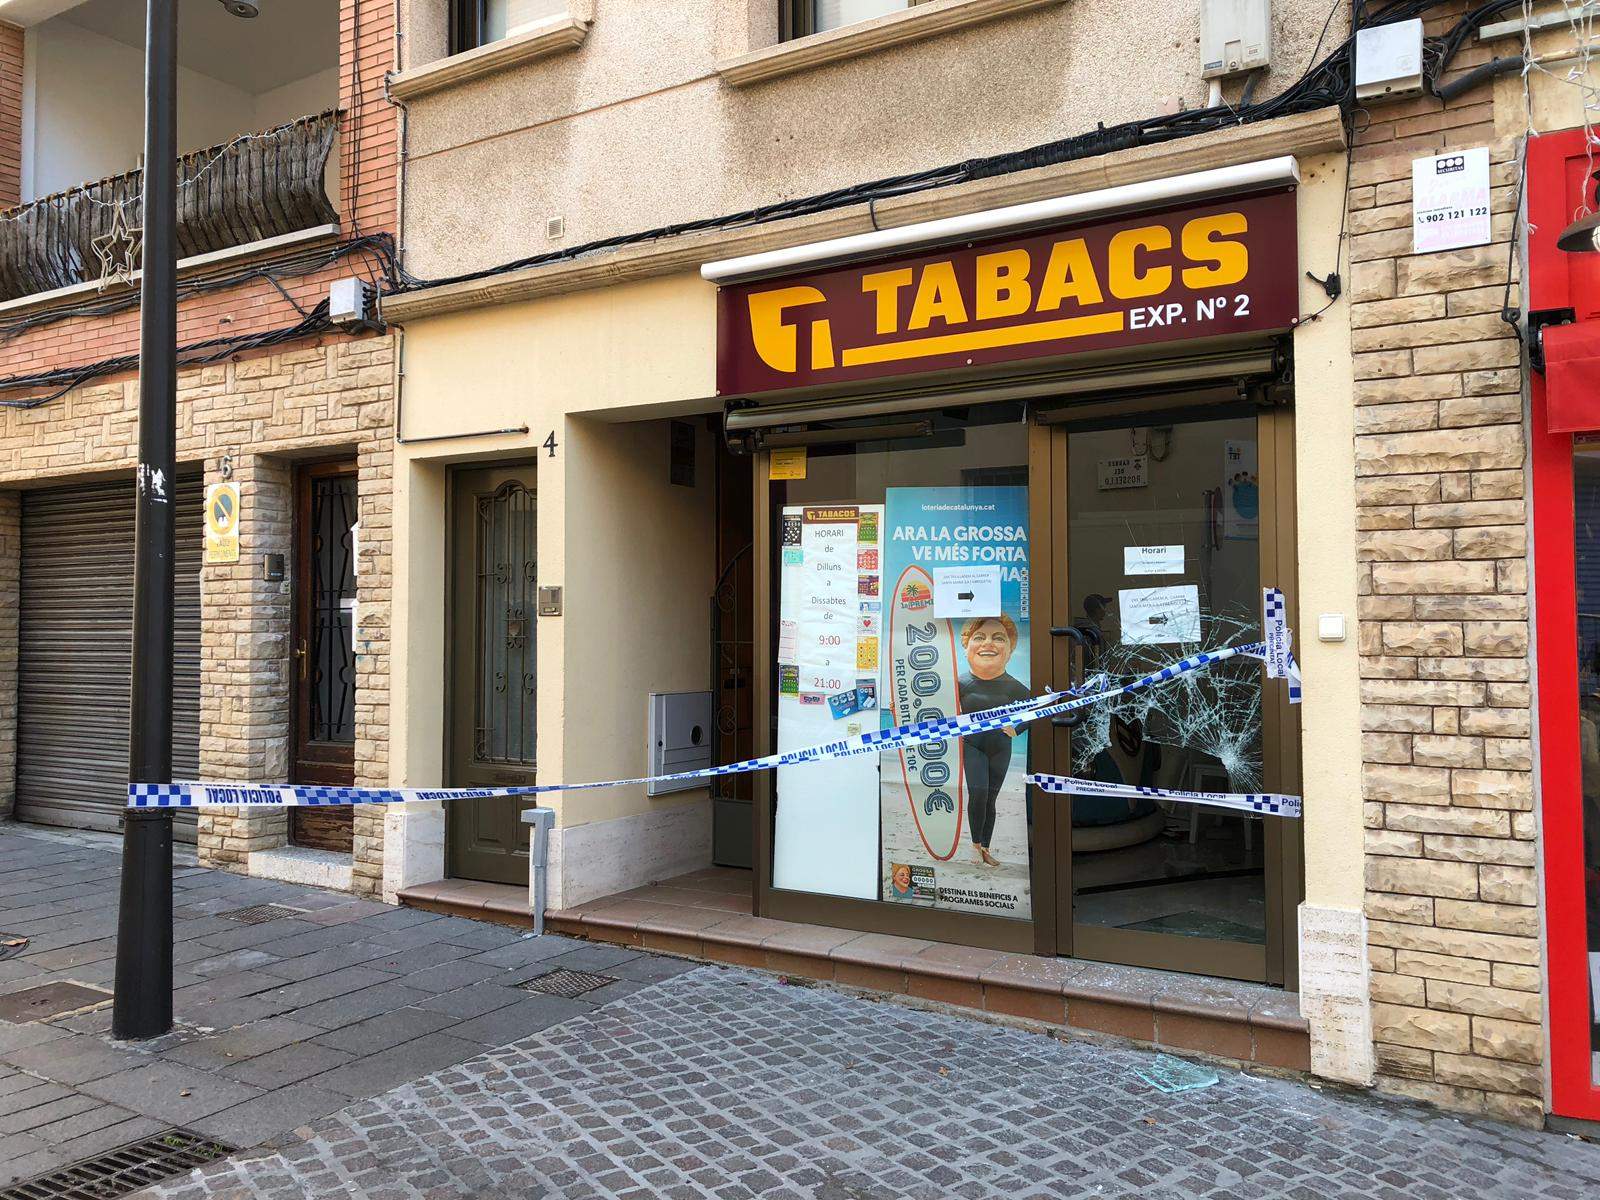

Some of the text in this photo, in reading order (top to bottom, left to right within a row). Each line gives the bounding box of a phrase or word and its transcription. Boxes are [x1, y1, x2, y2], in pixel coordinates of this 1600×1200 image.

[1426, 213, 1444, 223] 902
[1448, 210, 1465, 220] 121
[1470, 207, 1488, 217] 122
[862, 212, 1250, 335] TABACS
[1129, 294, 1250, 330] EXP. Nº 2
[542, 430, 558, 457] 4
[221, 455, 232, 479] 6
[921, 504, 995, 512] loteriadecatalunya.cat
[814, 529, 844, 538] HORARI
[892, 526, 1027, 542] ARA LA GROSSA
[824, 544, 834, 553] de
[911, 543, 1027, 562] VE MÉS FORTA
[1141, 546, 1167, 554] Horari
[816, 562, 842, 571] Dilluns
[811, 596, 847, 605] Dissabtes
[823, 612, 834, 620] de
[818, 635, 841, 646] 9:00
[1275, 619, 1286, 677] Policia Local
[895, 658, 906, 677] PER
[814, 677, 841, 689] 21:00
[897, 678, 910, 704] CADA
[1034, 702, 1074, 718] POLICIA
[1075, 694, 1104, 708] LOCA
[900, 705, 911, 725] BITL
[907, 754, 918, 772] 10€
[205, 787, 283, 804] POLICIA LOCAL
[939, 886, 966, 897] DESTINA
[967, 889, 978, 898] ELS
[979, 890, 1012, 902] BENEFICIS
[1012, 894, 1019, 903] A
[939, 895, 1015, 910] PROGRAMES SOCIALS
